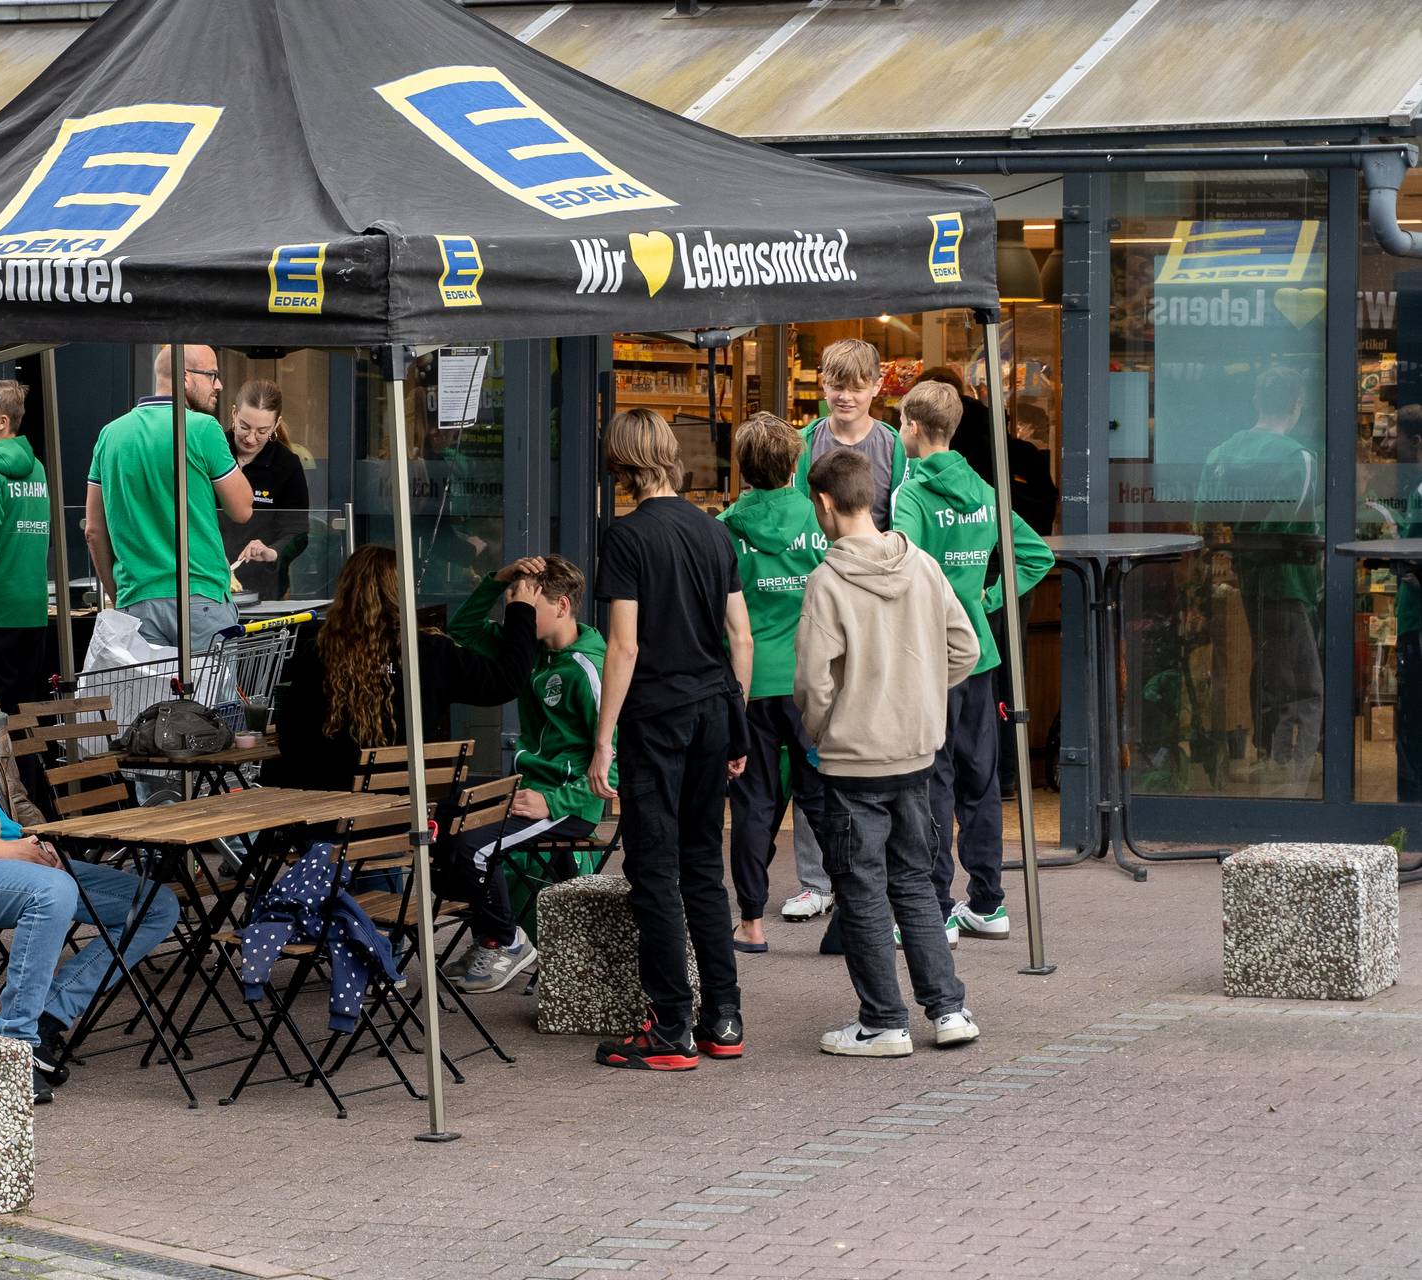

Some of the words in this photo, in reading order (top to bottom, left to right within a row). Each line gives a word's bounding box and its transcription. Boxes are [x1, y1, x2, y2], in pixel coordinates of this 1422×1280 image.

[535, 182, 652, 210] EDEKA
[570, 238, 626, 294] Wir
[675, 228, 857, 290] Lebensmittel.
[933, 267, 957, 277] EDEKA
[274, 296, 318, 307] EDEKA
[445, 290, 477, 300] EDEKA
[7, 482, 22, 498] TS
[23, 481, 47, 498] RAHM
[935, 508, 955, 528] TS
[811, 532, 828, 551] 06
[945, 550, 988, 560] BREMER
[757, 575, 808, 587] BREMER
